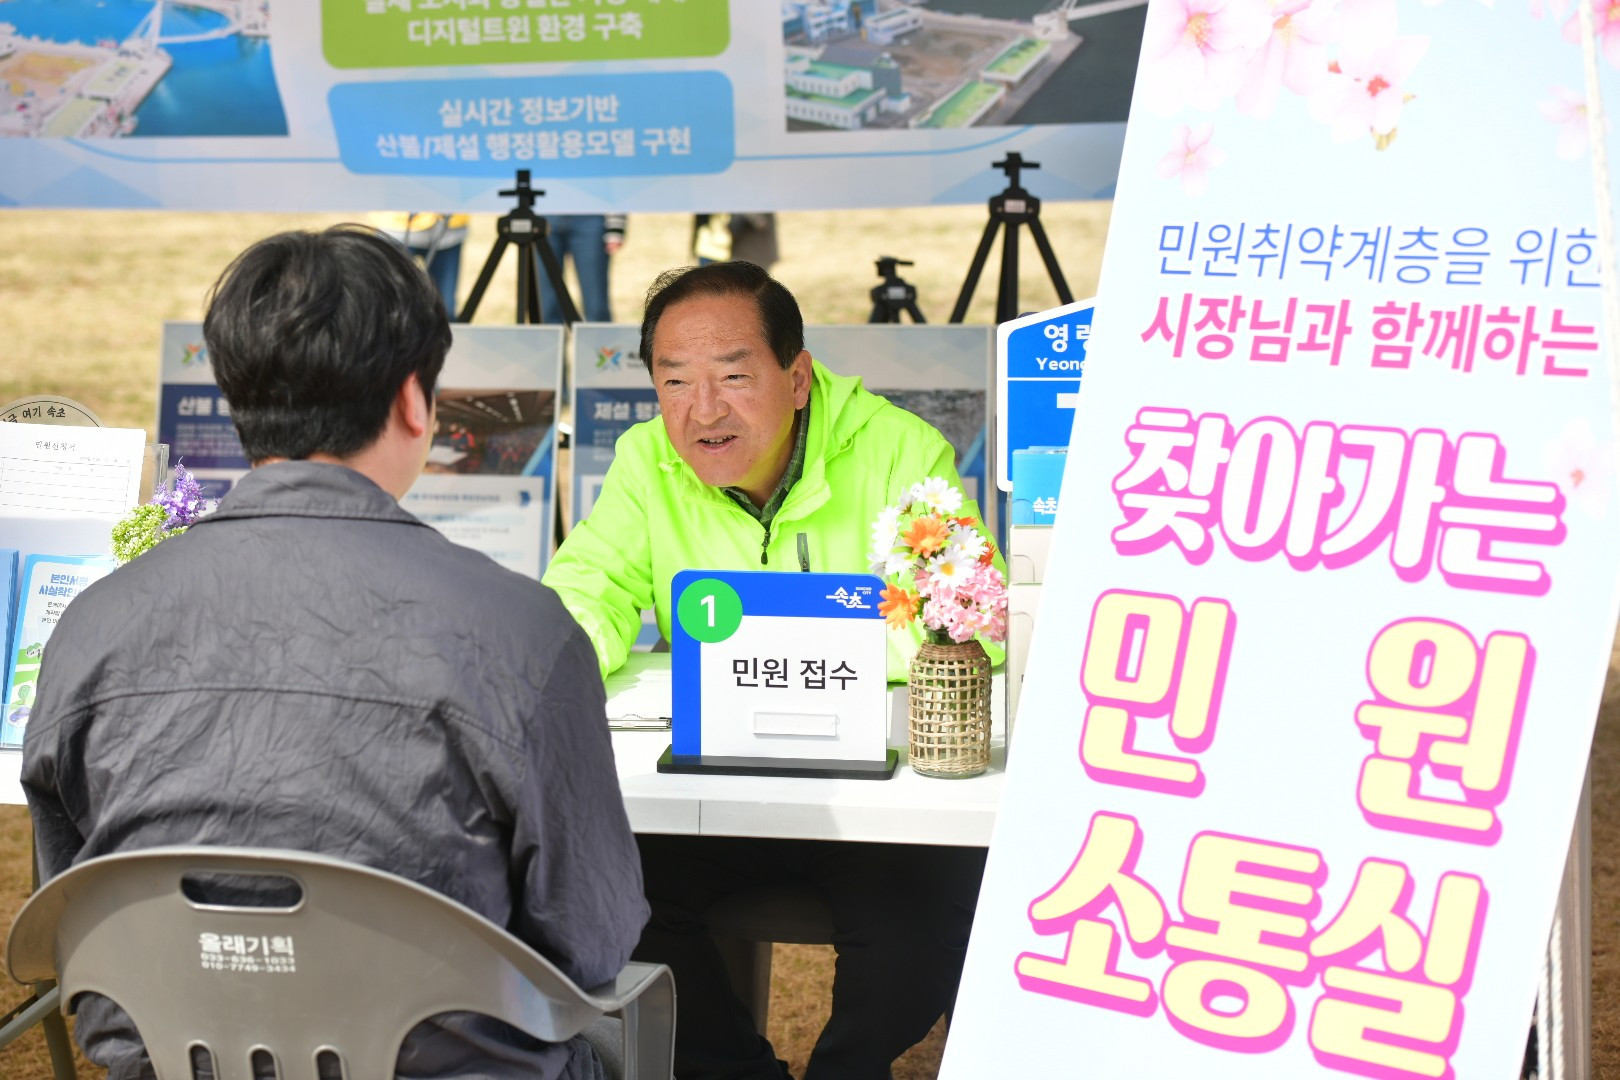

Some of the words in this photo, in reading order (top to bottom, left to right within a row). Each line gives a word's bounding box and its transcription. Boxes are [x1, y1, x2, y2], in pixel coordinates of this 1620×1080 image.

[407, 18, 531, 46] 디지털트윈
[537, 13, 586, 42] 환경
[592, 12, 644, 40] 구축
[439, 99, 513, 128] 실시간
[519, 94, 620, 125] 정보기반
[375, 133, 481, 160] 산불/제설
[485, 129, 636, 160] 행정활용모델
[641, 127, 692, 156] 구현
[1158, 221, 1491, 286] 민원취약계층을
[1140, 293, 1353, 367] 시장님과
[1371, 300, 1599, 378] 함께하는
[22, 406, 42, 419] 여기
[46, 405, 66, 418] 속초
[1110, 406, 1568, 598] 찾아가는
[700, 595, 716, 627] 1
[825, 586, 872, 609] 속초
[732, 657, 789, 689] 민원
[799, 658, 858, 691] 접수
[1014, 810, 1490, 1080] 소통실
